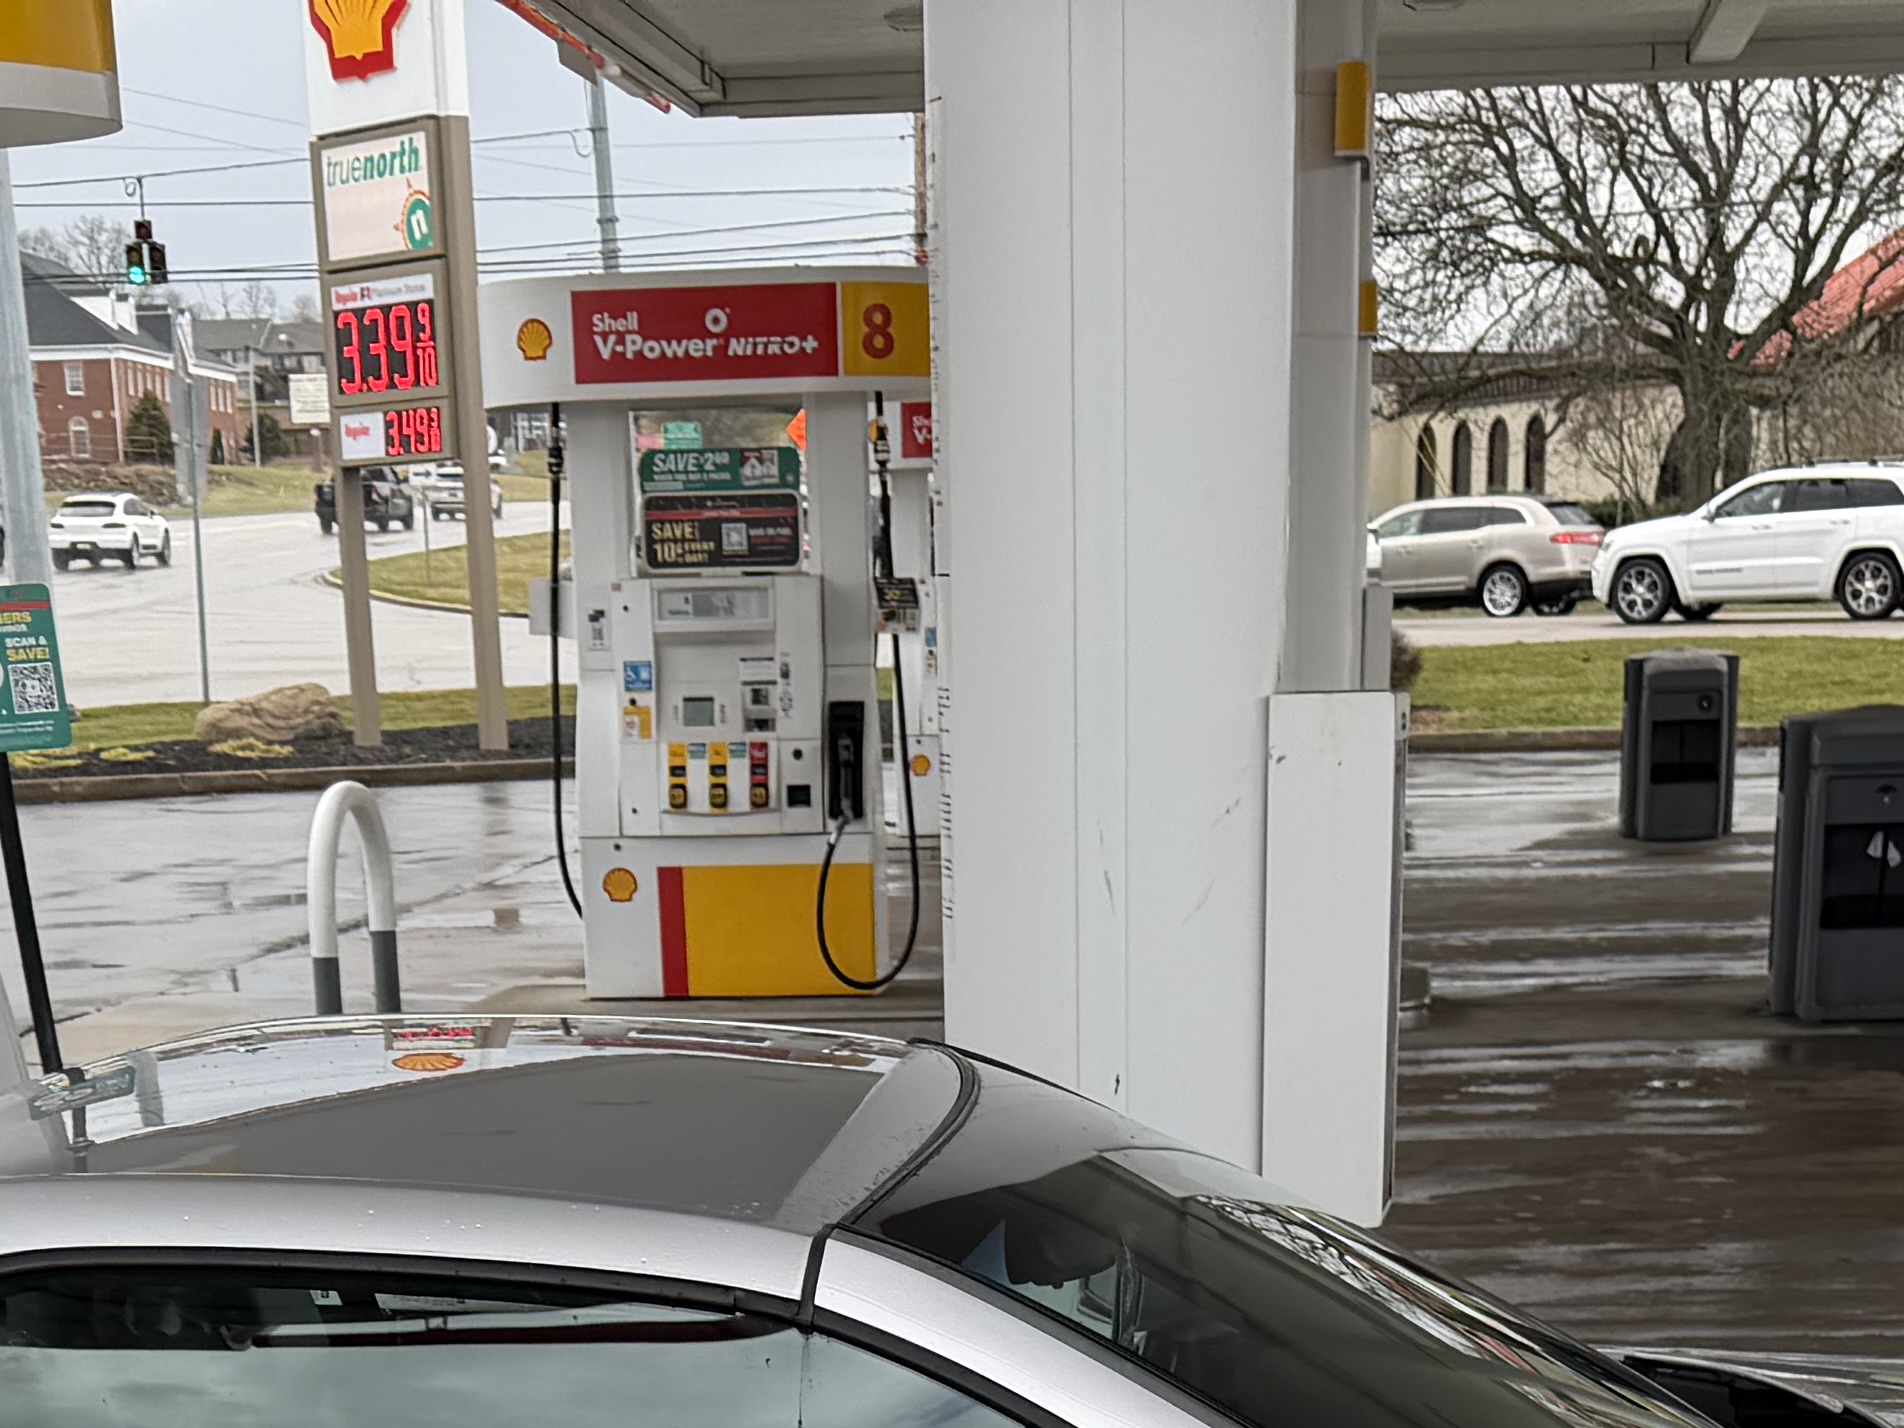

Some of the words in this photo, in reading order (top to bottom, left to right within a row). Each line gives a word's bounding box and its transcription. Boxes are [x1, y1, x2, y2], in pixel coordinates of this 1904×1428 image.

[327, 136, 420, 188] truenorth
[592, 311, 638, 332] Shell
[862, 302, 895, 359] 8
[337, 304, 415, 395] 3.39
[594, 333, 719, 360] V-Power
[653, 453, 697, 472] SAVE
